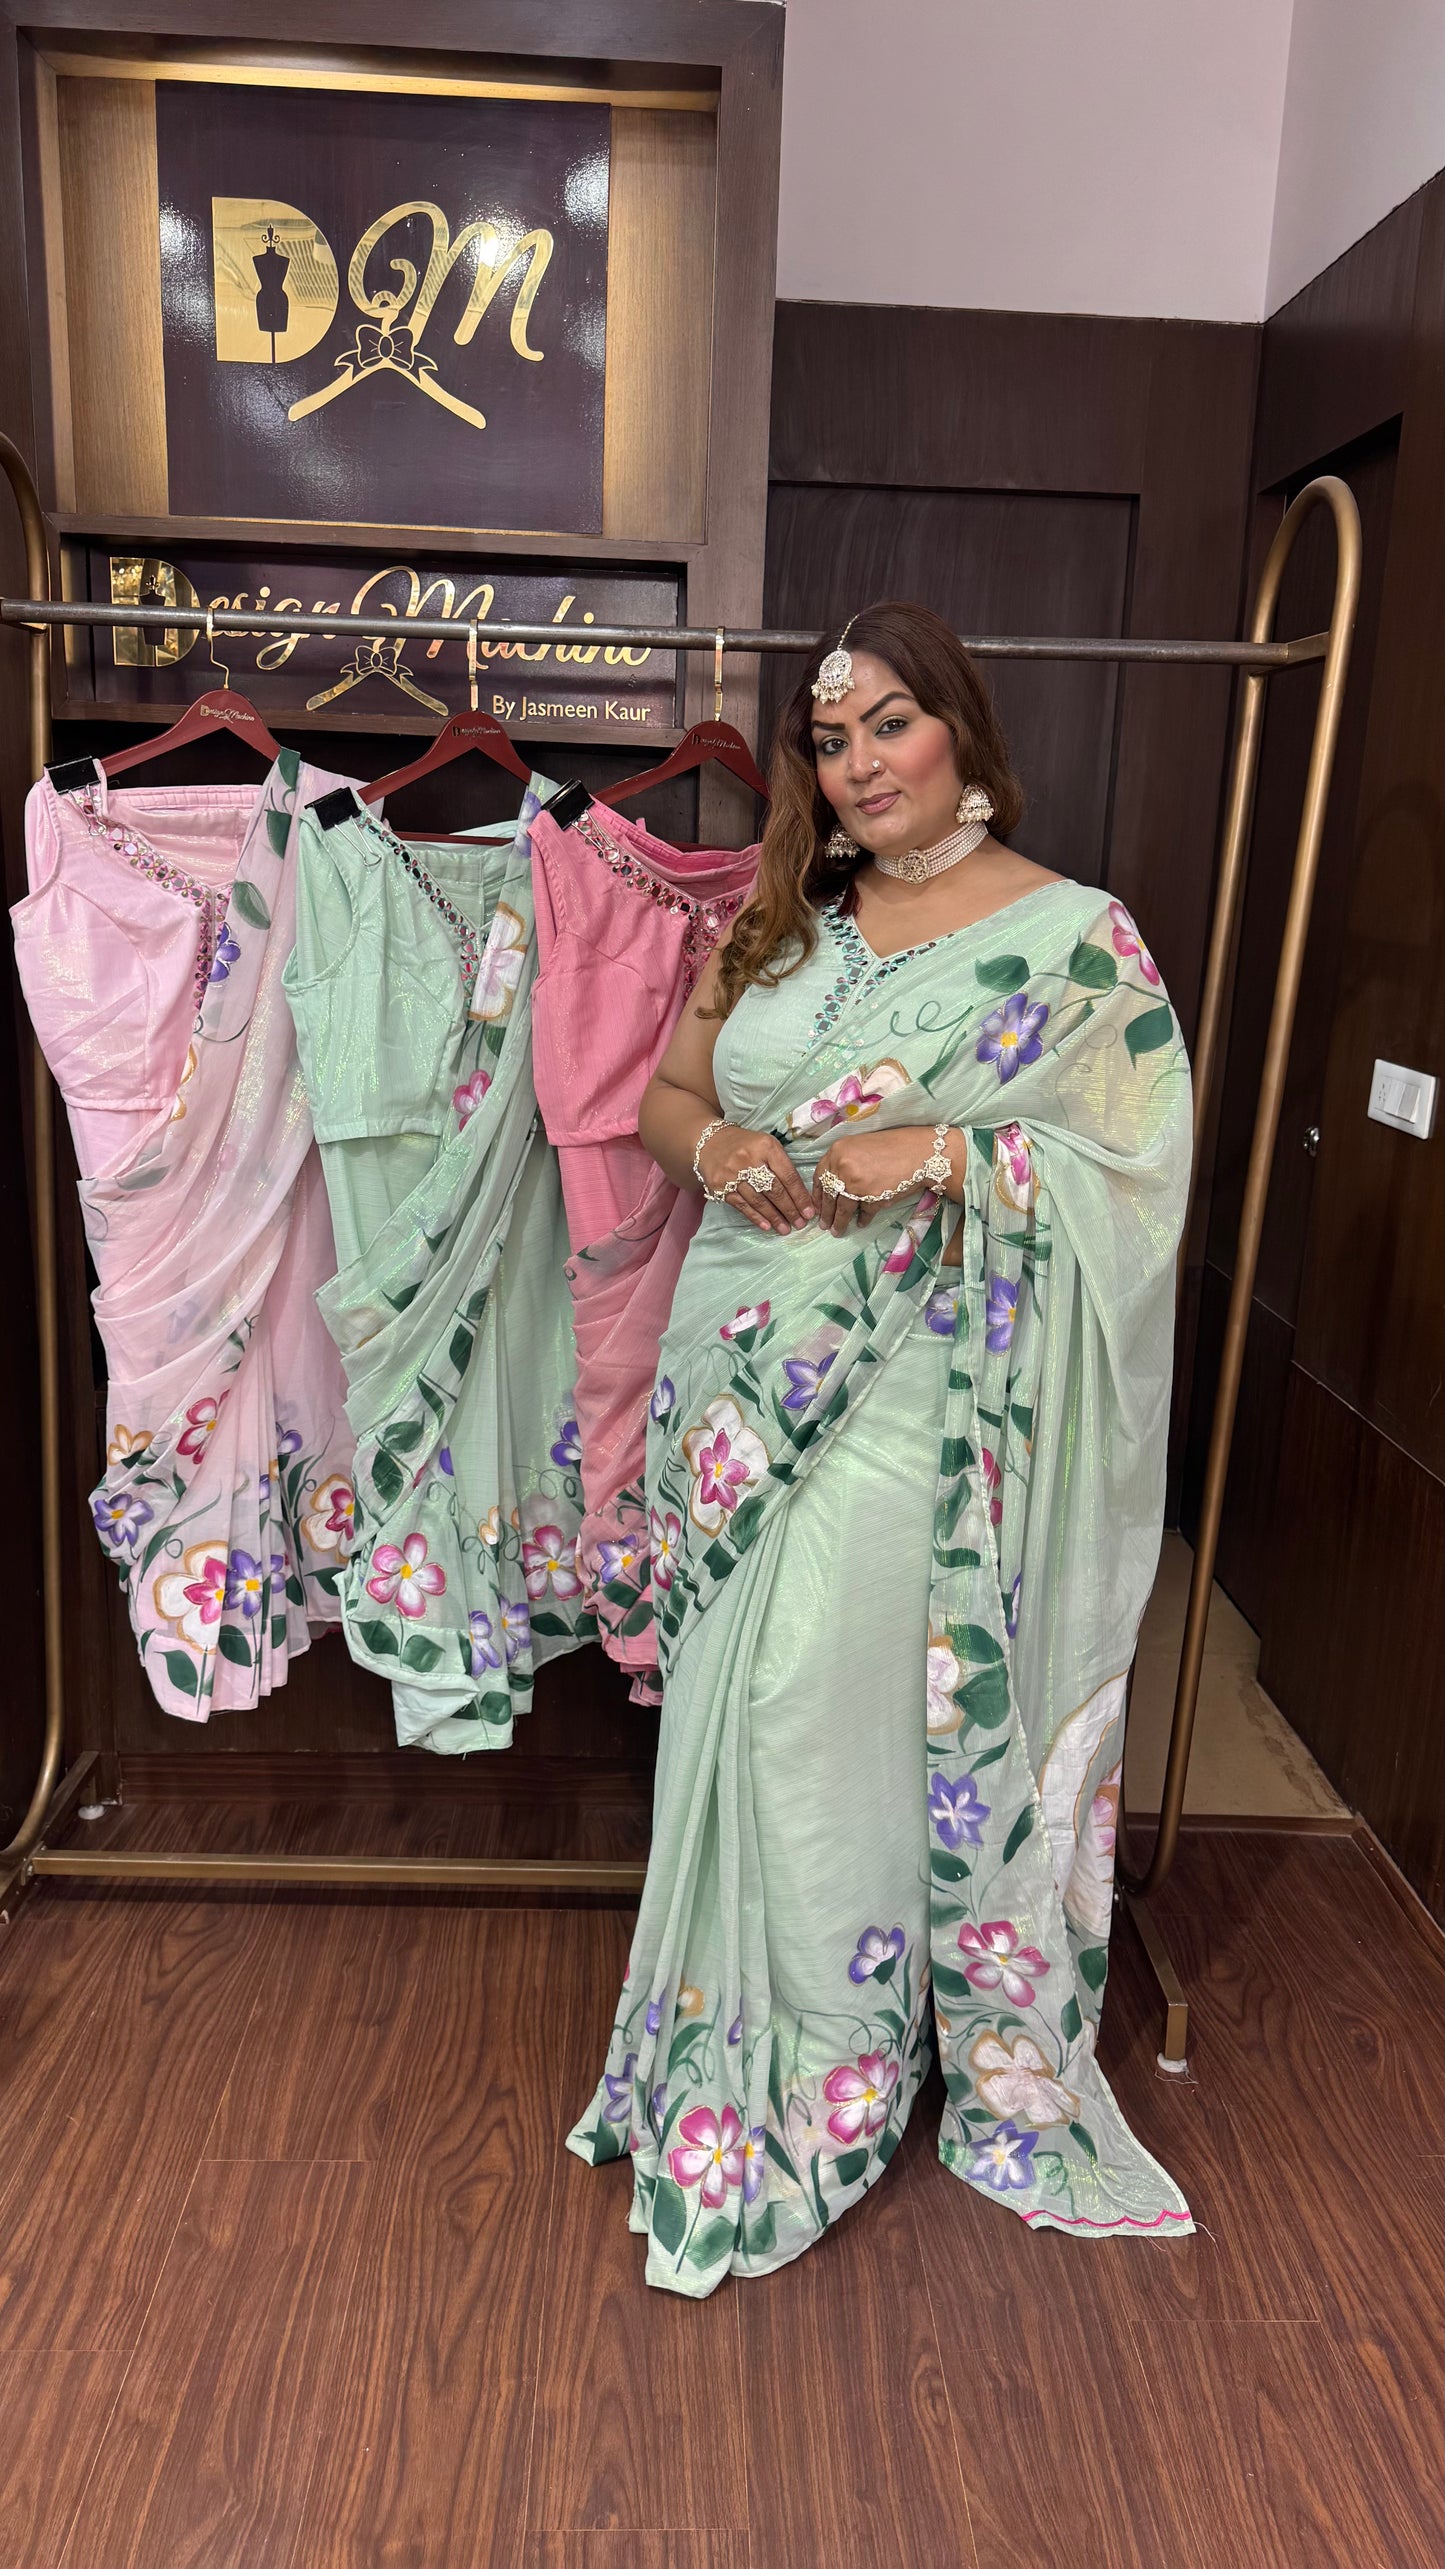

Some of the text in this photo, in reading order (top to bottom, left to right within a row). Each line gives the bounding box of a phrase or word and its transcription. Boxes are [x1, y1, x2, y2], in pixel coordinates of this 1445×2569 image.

[492, 694, 651, 721] By Jasmeen Kaur
